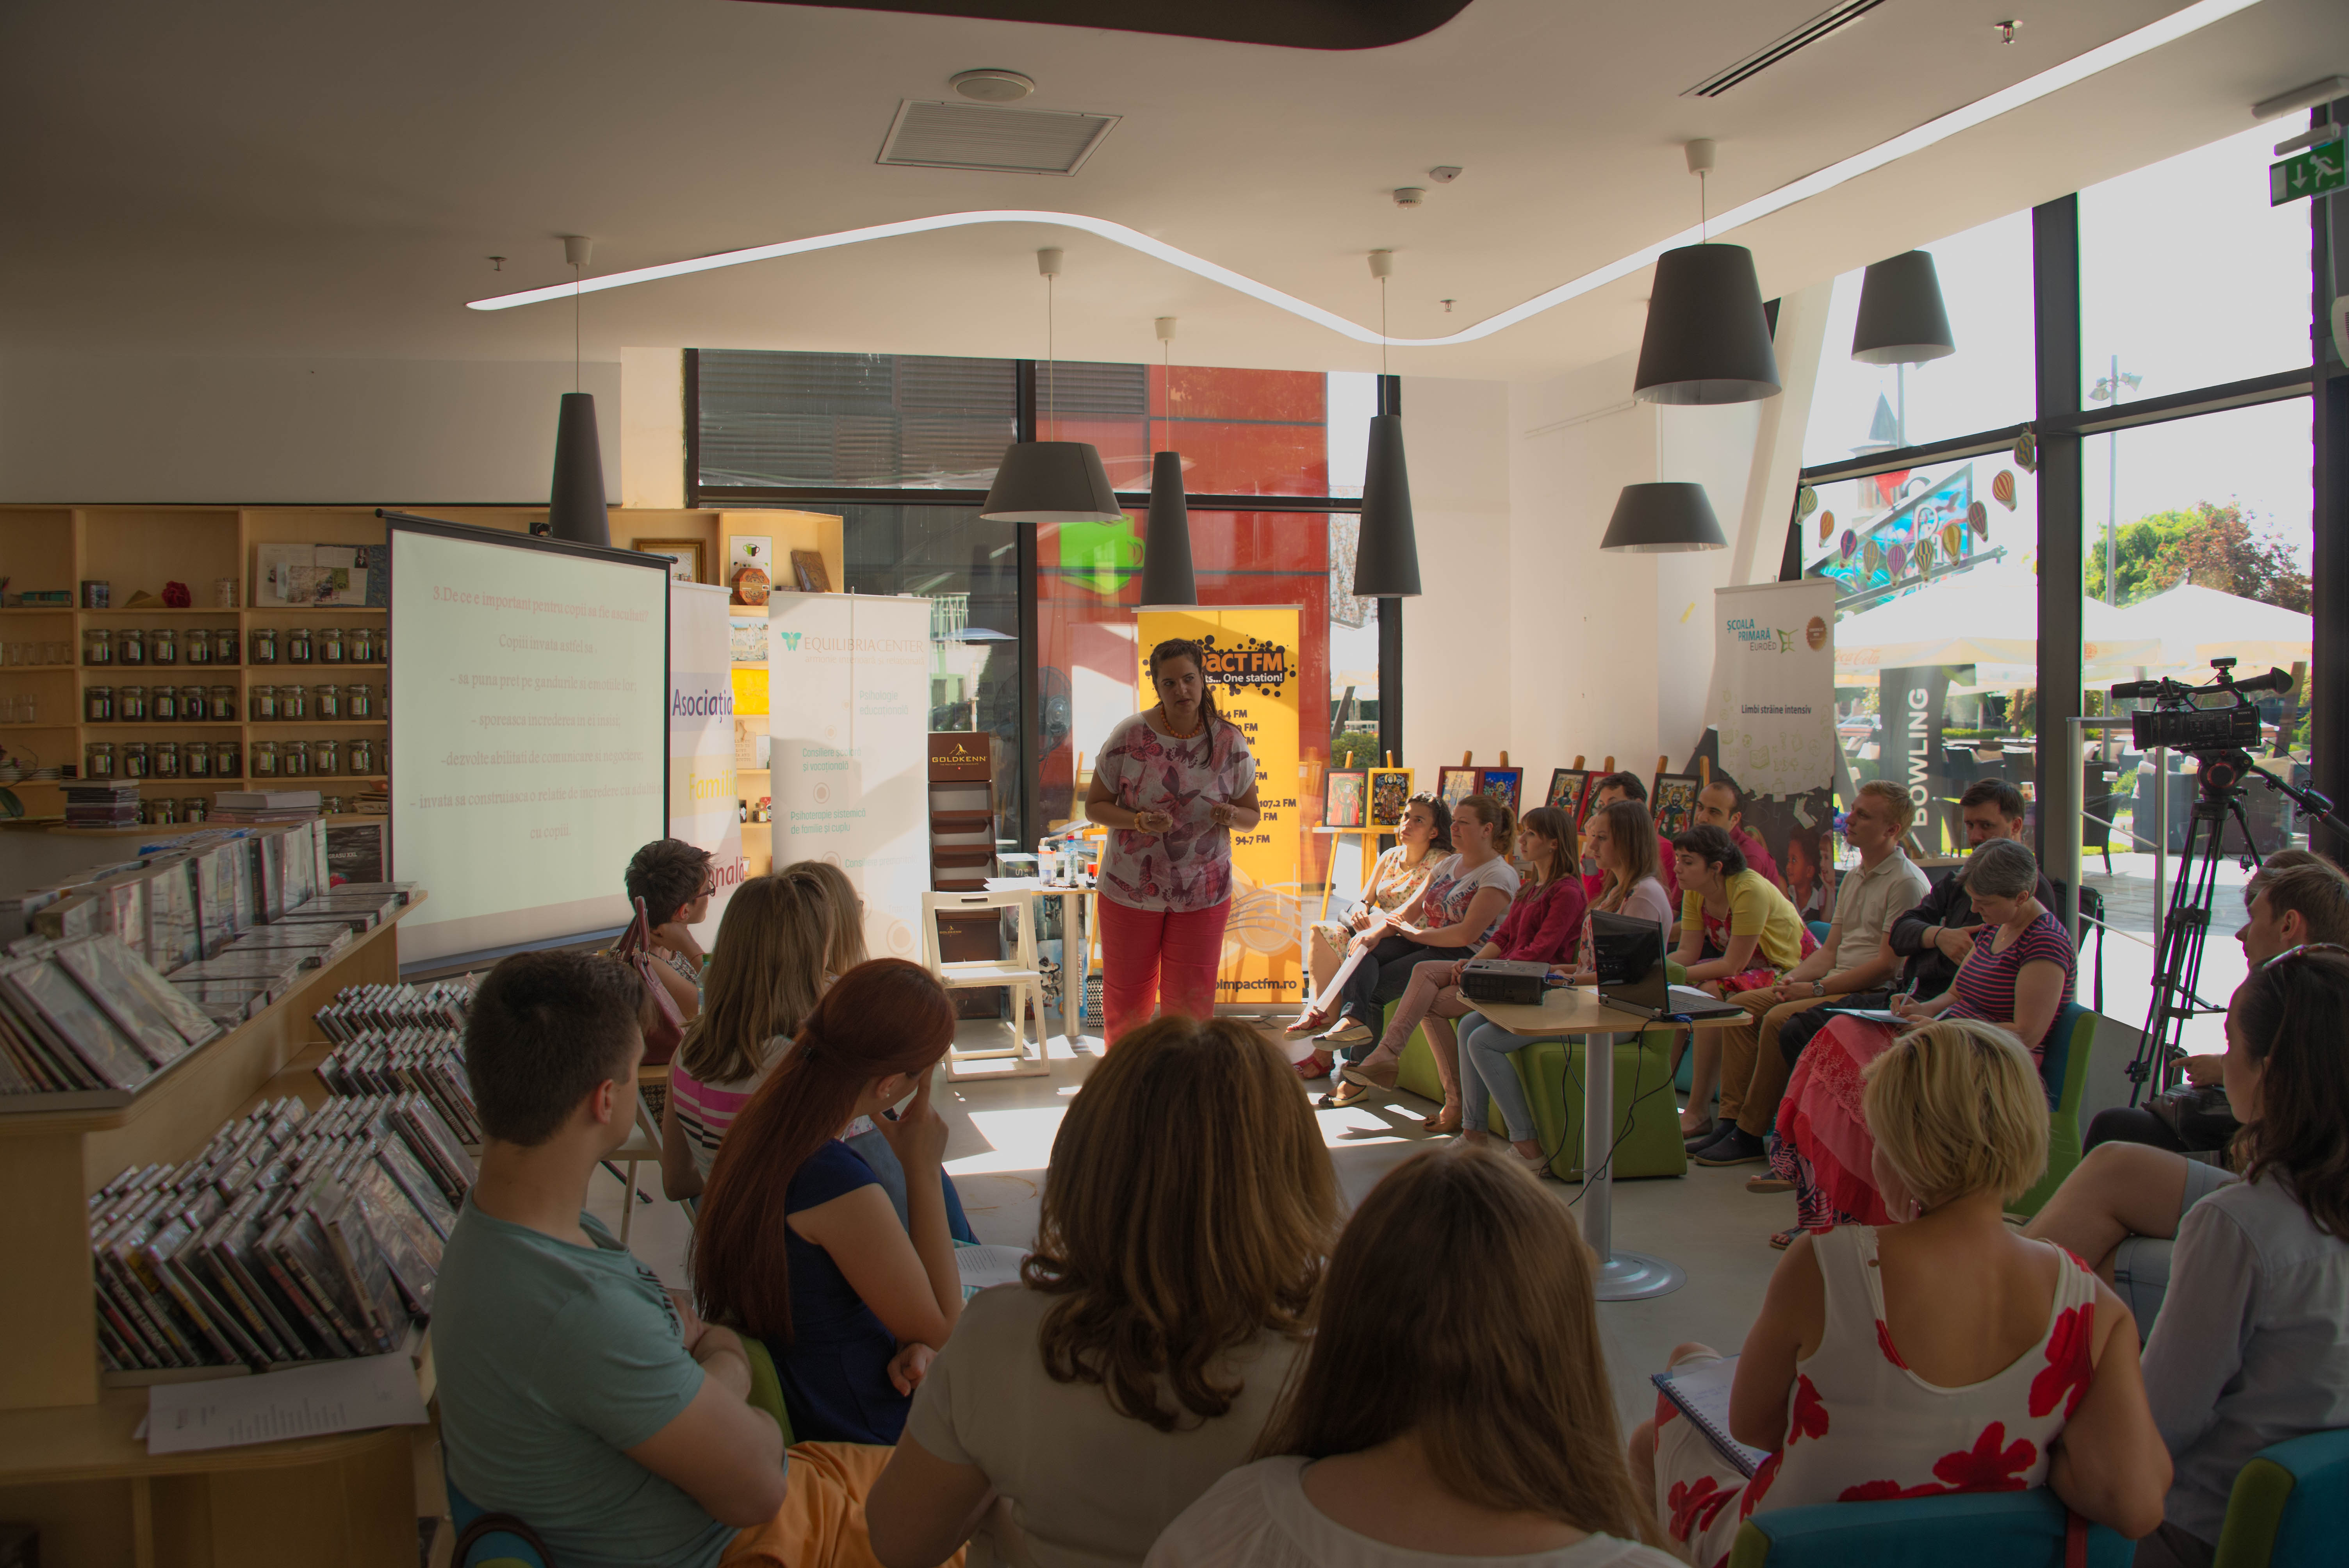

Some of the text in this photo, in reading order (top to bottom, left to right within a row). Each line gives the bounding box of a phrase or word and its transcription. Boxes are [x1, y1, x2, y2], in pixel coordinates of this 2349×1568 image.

[460, 592, 472, 604] ce
[474, 593, 480, 605] e
[482, 591, 531, 611] important
[532, 599, 563, 615] pentru
[565, 603, 586, 618] copii
[588, 607, 597, 618] sa
[598, 605, 610, 619] fie
[611, 607, 649, 622] ascultati?
[1738, 627, 1771, 641] PRIMARĂ
[499, 634, 529, 652] Copiii
[530, 636, 558, 650] invata
[560, 639, 583, 653] astfel
[804, 655, 837, 663] armonie
[1251, 653, 1283, 672] FM
[458, 674, 469, 684] sa
[472, 674, 498, 689] puna
[500, 675, 520, 690] pret
[522, 677, 533, 691] pe
[534, 675, 578, 691] gandurile
[579, 677, 586, 690] si
[588, 677, 621, 691] emotiile
[1223, 674, 1244, 683] One
[1245, 673, 1283, 683] station!
[859, 690, 898, 702] Psihologie
[672, 688, 733, 723] Asociația
[1741, 705, 1759, 714] Limbi
[1784, 704, 1812, 714] intensiv
[1233, 709, 1248, 718] FM
[479, 715, 526, 729] sporeasca
[528, 713, 576, 727] increderea
[577, 714, 585, 726] in
[587, 715, 596, 726] ei
[597, 714, 621, 729] insisi;
[1244, 723, 1258, 731] FM
[490, 750, 527, 765] abilitati
[529, 750, 540, 763] de
[541, 750, 593, 764] comunicare
[595, 750, 601, 763] si
[603, 747, 643, 764] negociere;
[802, 747, 834, 757] Consiliere
[1908, 688, 1929, 826] BOWLING
[419, 794, 453, 809] invata
[454, 795, 466, 807] sa
[468, 790, 528, 806] construiasca
[529, 792, 536, 802] o
[537, 787, 567, 801] relatie
[568, 786, 579, 800] de
[580, 784, 619, 799] incredere
[620, 786, 630, 797] cu
[631, 781, 656, 796] adultii
[1283, 798, 1297, 807] FM
[790, 807, 866, 821] Psihoterapie sistemică
[1264, 813, 1278, 821] FM
[530, 827, 542, 839] cu
[791, 824, 800, 834] de
[802, 823, 823, 834] familie
[831, 822, 851, 833] cuplu
[1235, 834, 1270, 845] 94.7 FM
[845, 857, 878, 868] Consiliere
